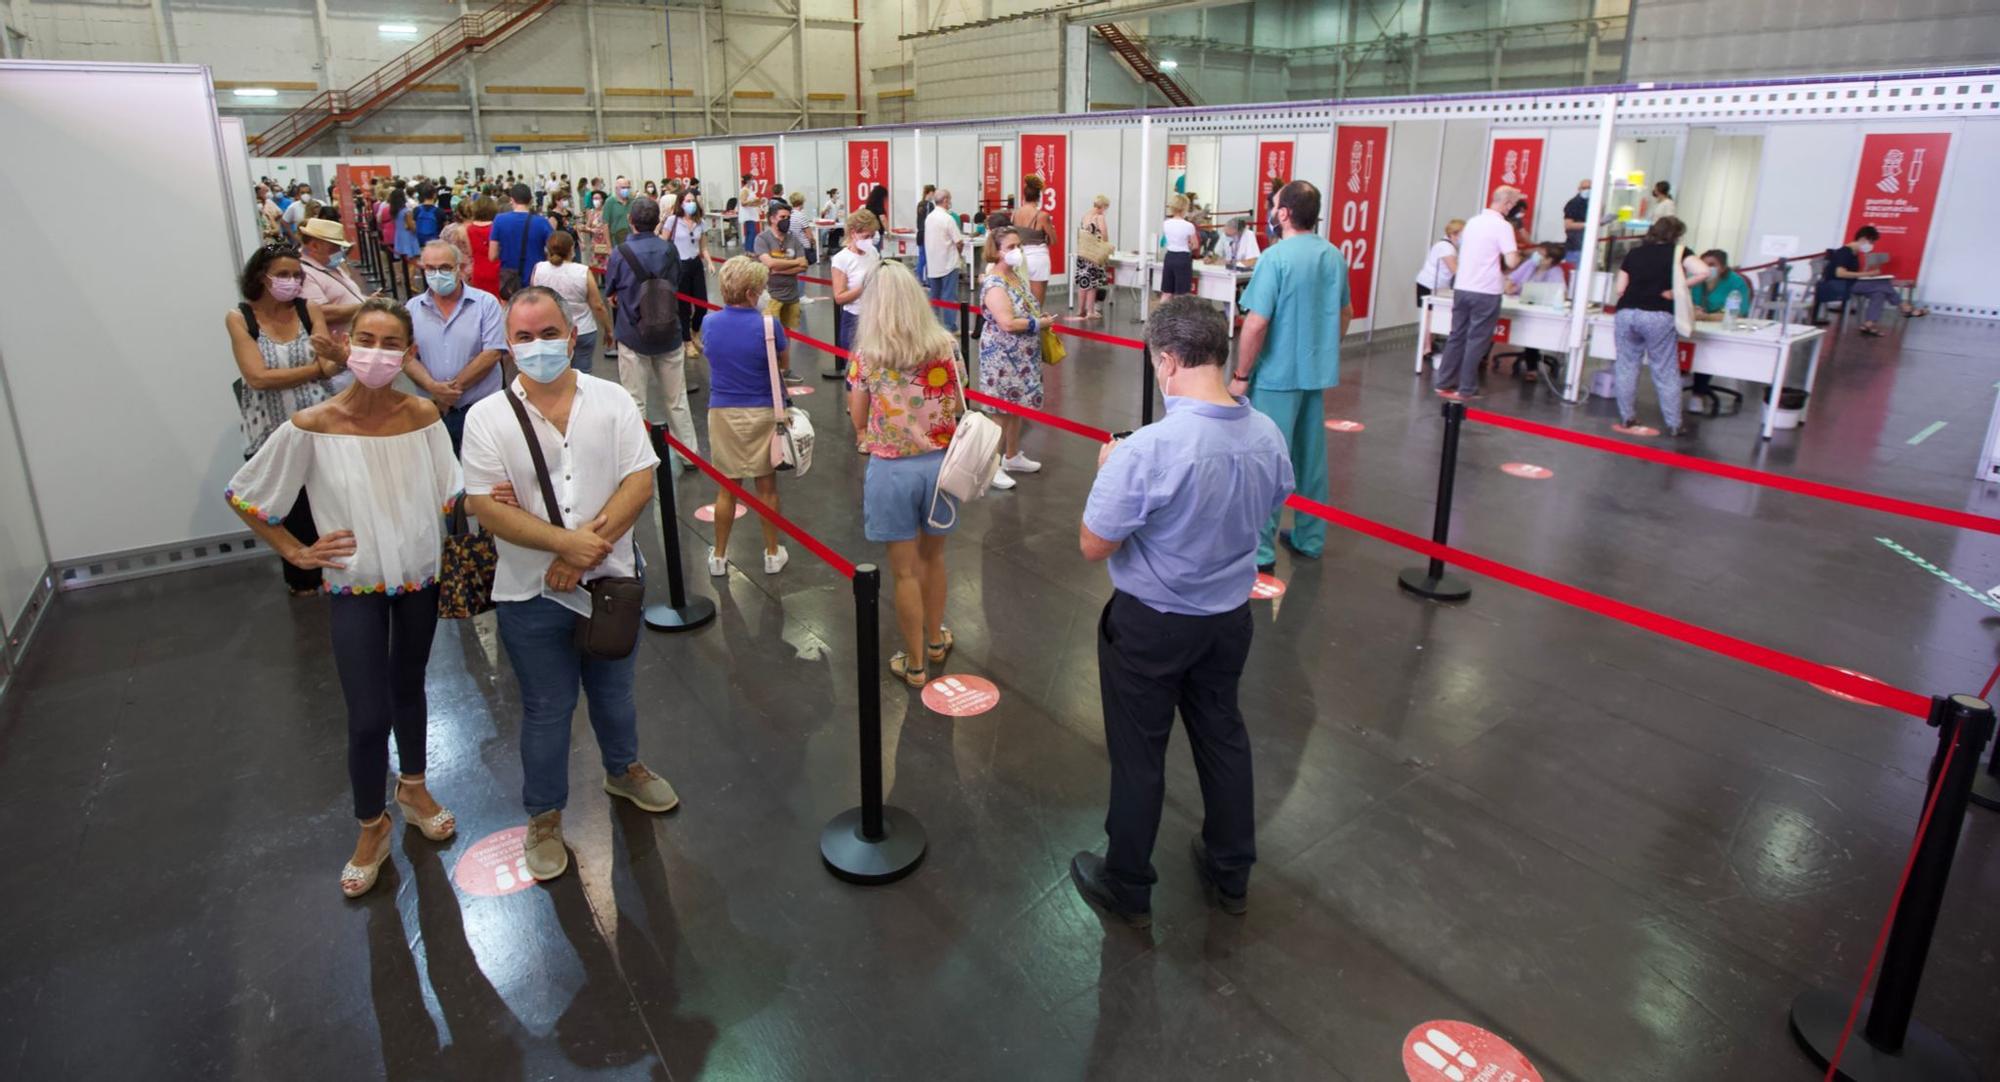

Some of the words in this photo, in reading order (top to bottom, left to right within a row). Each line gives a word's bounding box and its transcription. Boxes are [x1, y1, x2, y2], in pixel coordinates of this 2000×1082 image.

[751, 179, 769, 194] 07
[1343, 200, 1369, 233] 01
[1340, 238, 1367, 270] 02
